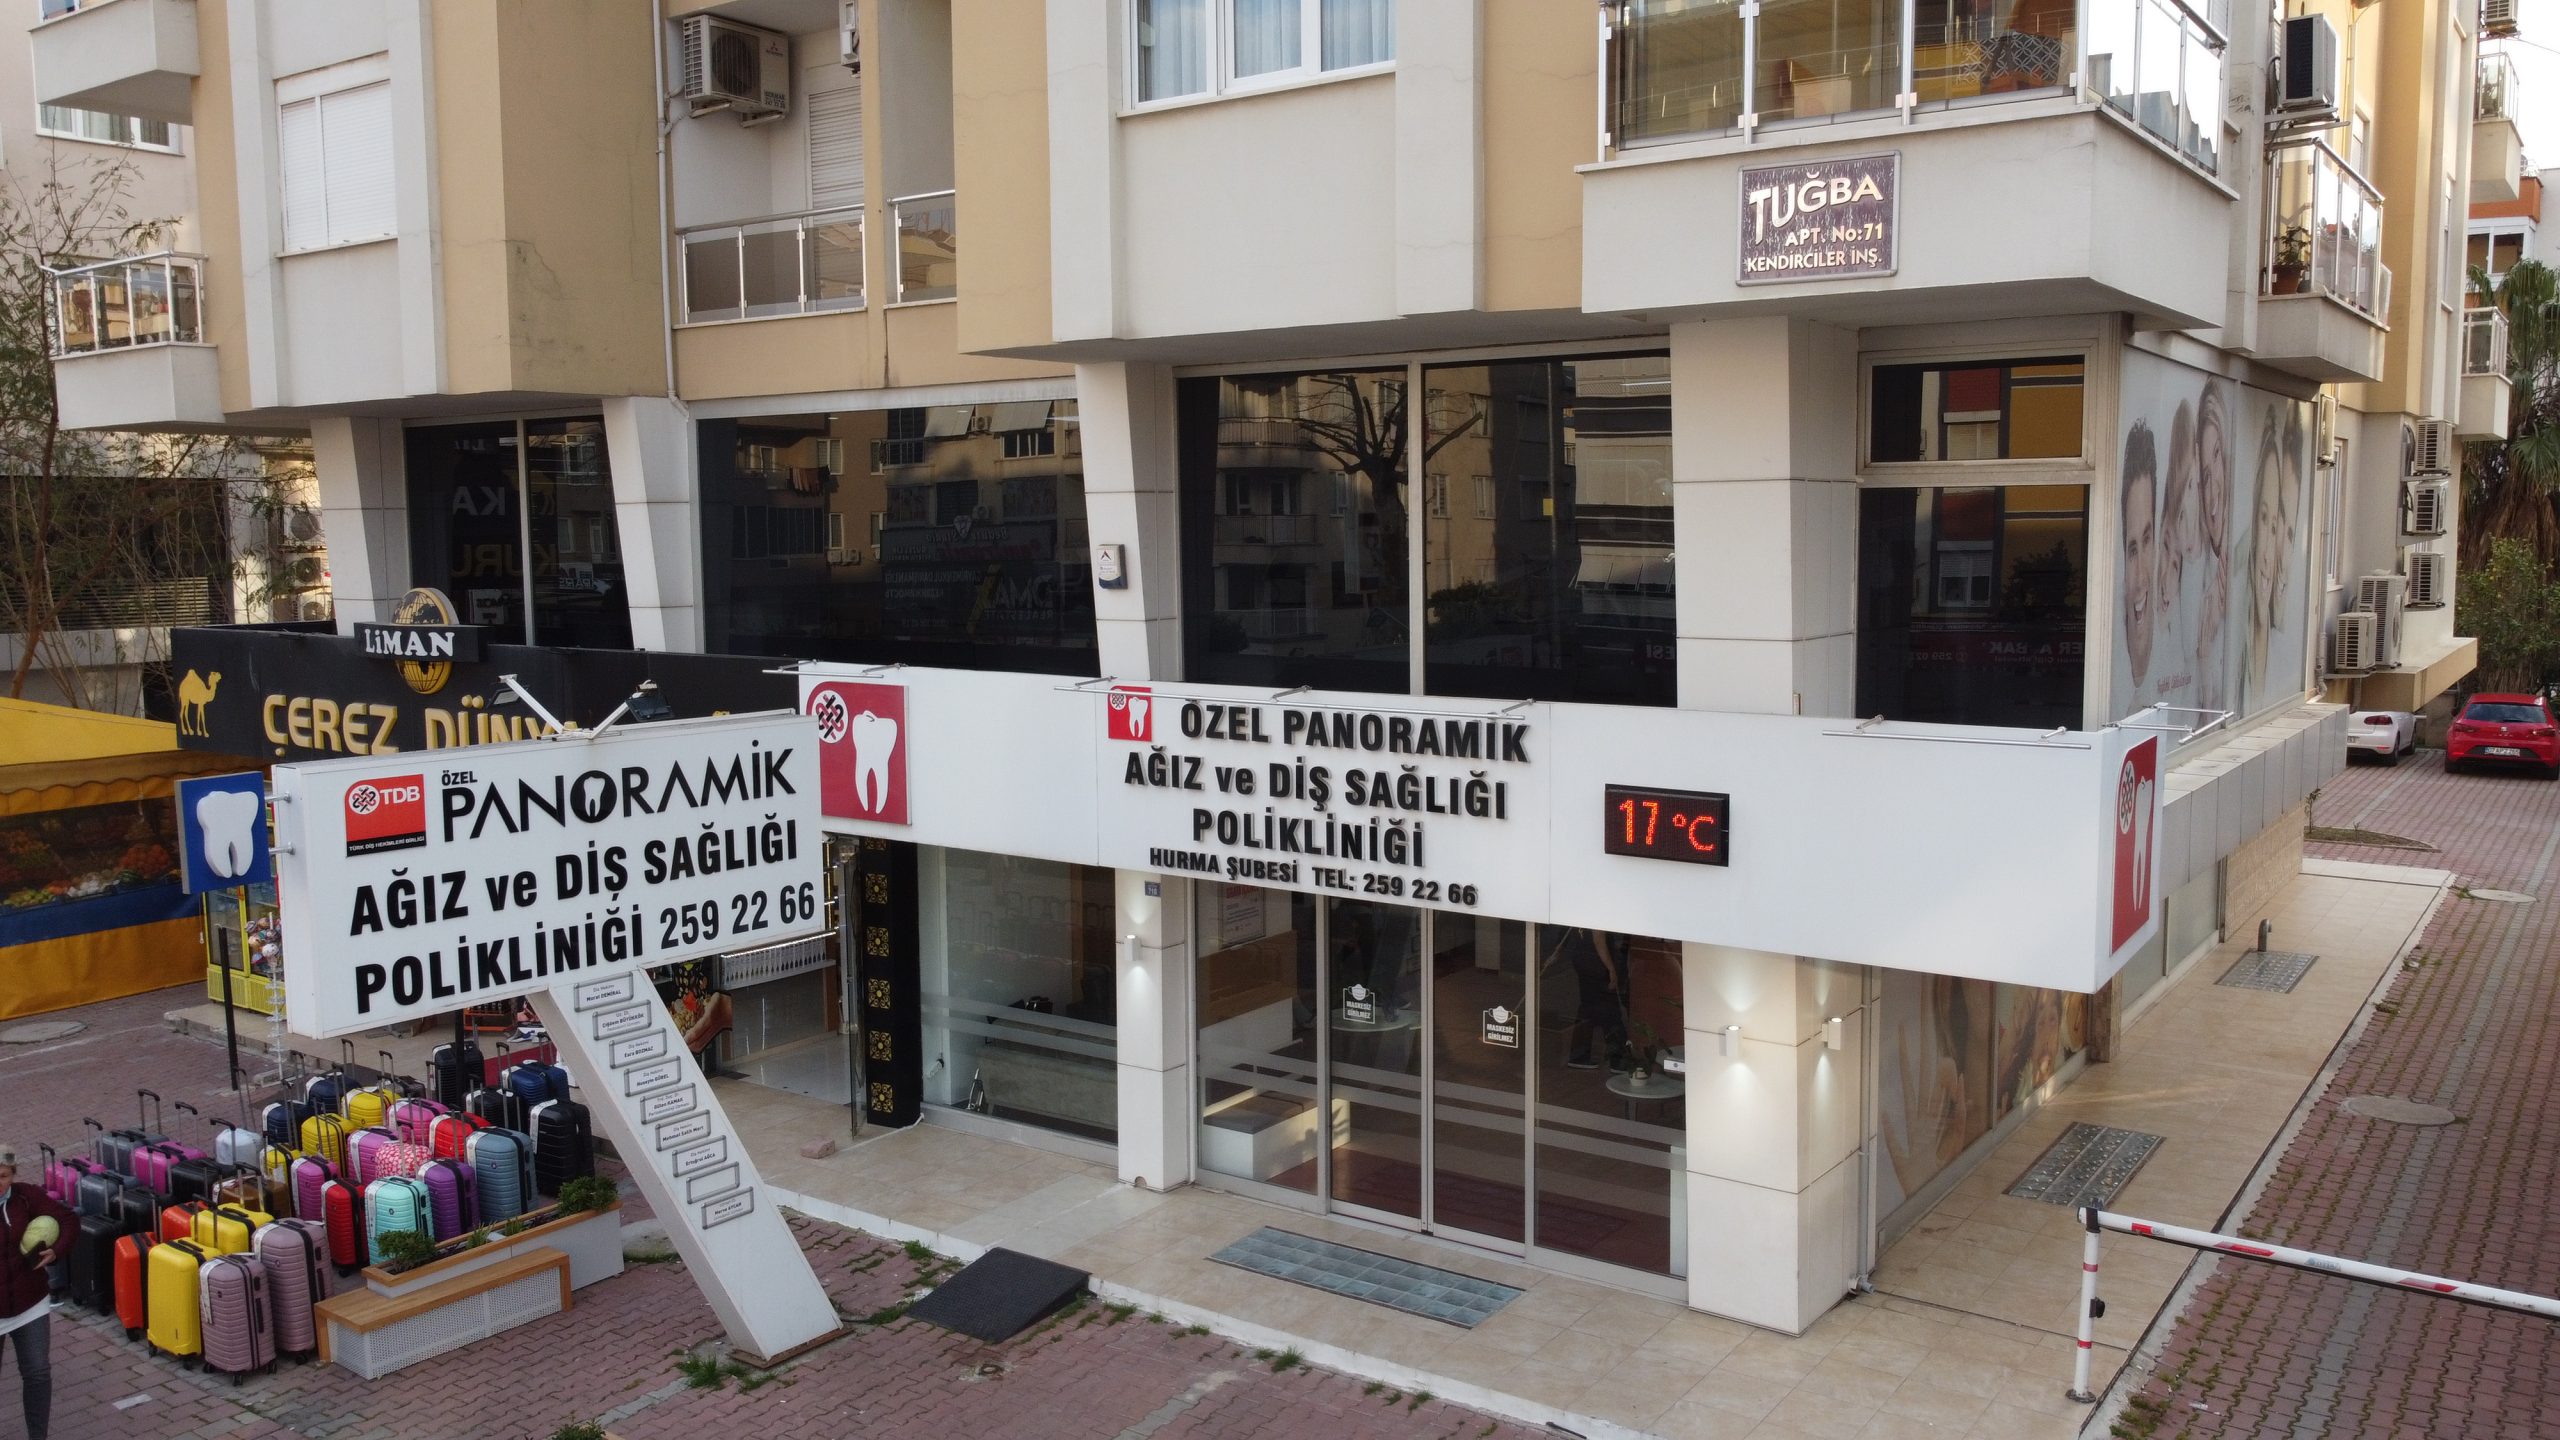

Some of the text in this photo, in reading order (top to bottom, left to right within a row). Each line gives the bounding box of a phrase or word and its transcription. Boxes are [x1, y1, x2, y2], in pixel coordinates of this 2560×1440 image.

[1749, 170, 1884, 245] TUĞBA
[1785, 223, 1883, 247] APT. No:71
[1747, 246, 1882, 273] KENDİRCİLER İNŞ.
[263, 693, 399, 758] ÇEREZ
[1181, 699, 1270, 743] ÖZEL
[380, 785, 420, 804] TDB
[441, 769, 479, 787] ÖZEL
[442, 739, 798, 843] PANORAMİK
[1124, 744, 1508, 820] AĞIZ ve DİŞ SAĞLIĞI
[1193, 807, 1425, 868] POLİKLİNİĞİ
[1619, 799, 1715, 852] 17 °C
[350, 812, 798, 937] AĞIZ ve DİŞ SAĞLIĞI
[1150, 847, 1478, 906] HURMA ŞUBESİ TEL: 259 22 66
[355, 881, 815, 1015] POLİKLİNİĞİ 259 22 66
[1346, 1000, 1372, 1011] MASKESİZ
[1347, 1009, 1372, 1019] GİRİLMEZ
[1486, 1023, 1515, 1035] MASKESİZ
[1487, 1031, 1514, 1043] GİRİLMEZ
